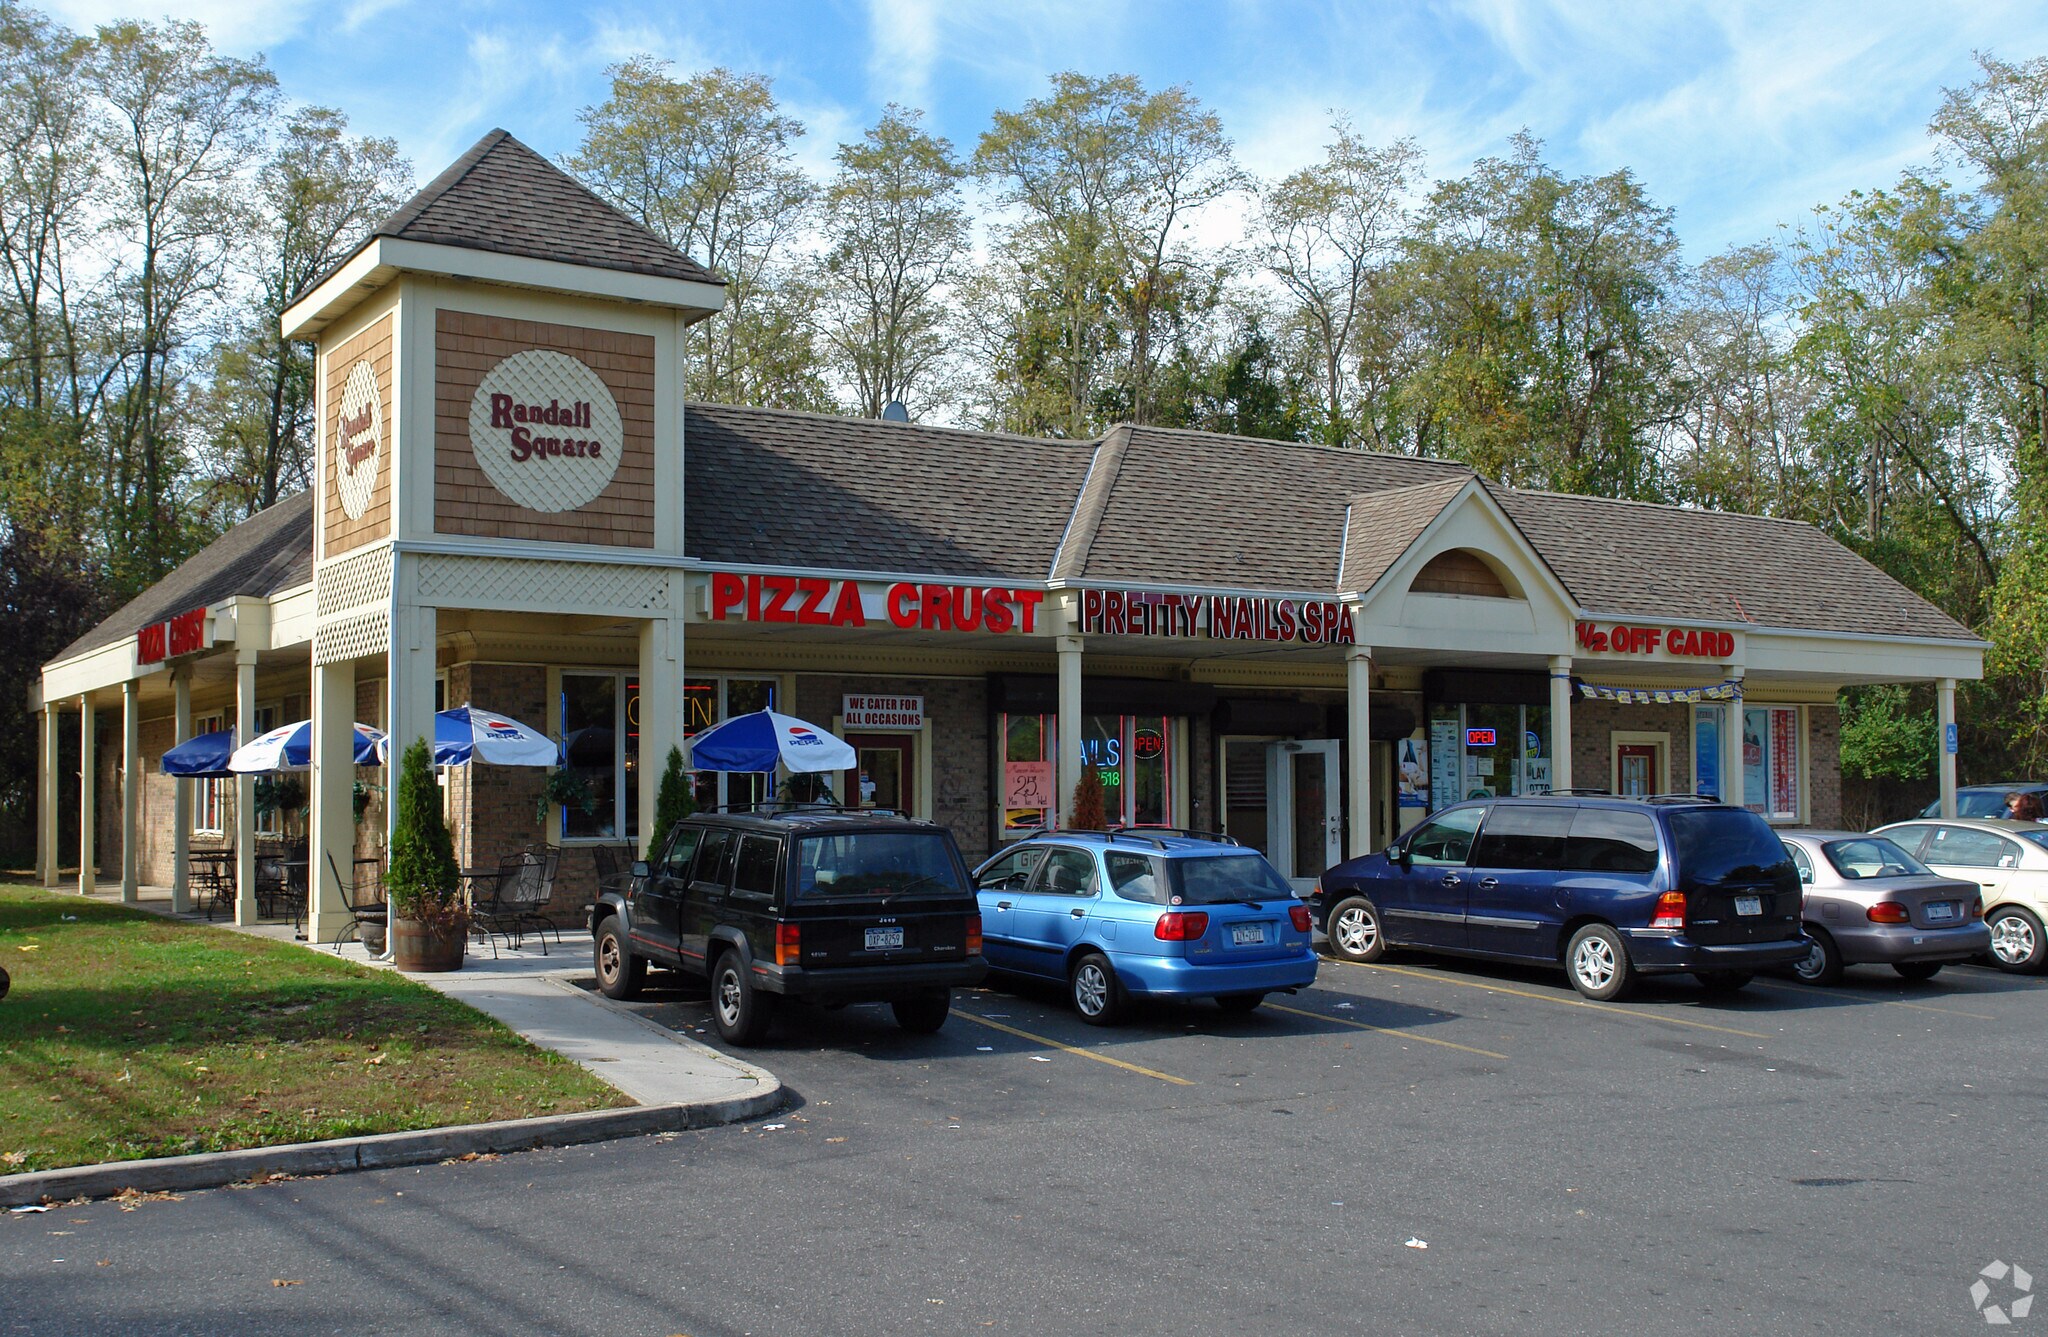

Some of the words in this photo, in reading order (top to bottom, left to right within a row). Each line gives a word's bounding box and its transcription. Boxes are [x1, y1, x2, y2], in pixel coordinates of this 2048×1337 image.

[490, 393, 591, 429] Randall
[510, 426, 601, 462] Square
[709, 572, 866, 627] PIZZA
[886, 582, 1044, 634] CRUST
[1080, 588, 1203, 637] PRETTY
[1210, 595, 1297, 642] NAILS
[1300, 600, 1356, 644] SPA
[1611, 625, 1662, 654] OFF
[1666, 628, 1735, 657] CARD
[627, 696, 712, 727] ON
[846, 712, 862, 725] ALL
[864, 712, 921, 726] OCCASIONS
[849, 697, 865, 710] WE
[867, 697, 897, 710] CATER
[900, 699, 918, 711] FOR
[1080, 738, 1120, 766] AILS
[1469, 731, 1495, 744] OPEN
[1779, 714, 1788, 812] CATERING
[1021, 853, 1041, 867] GIF
